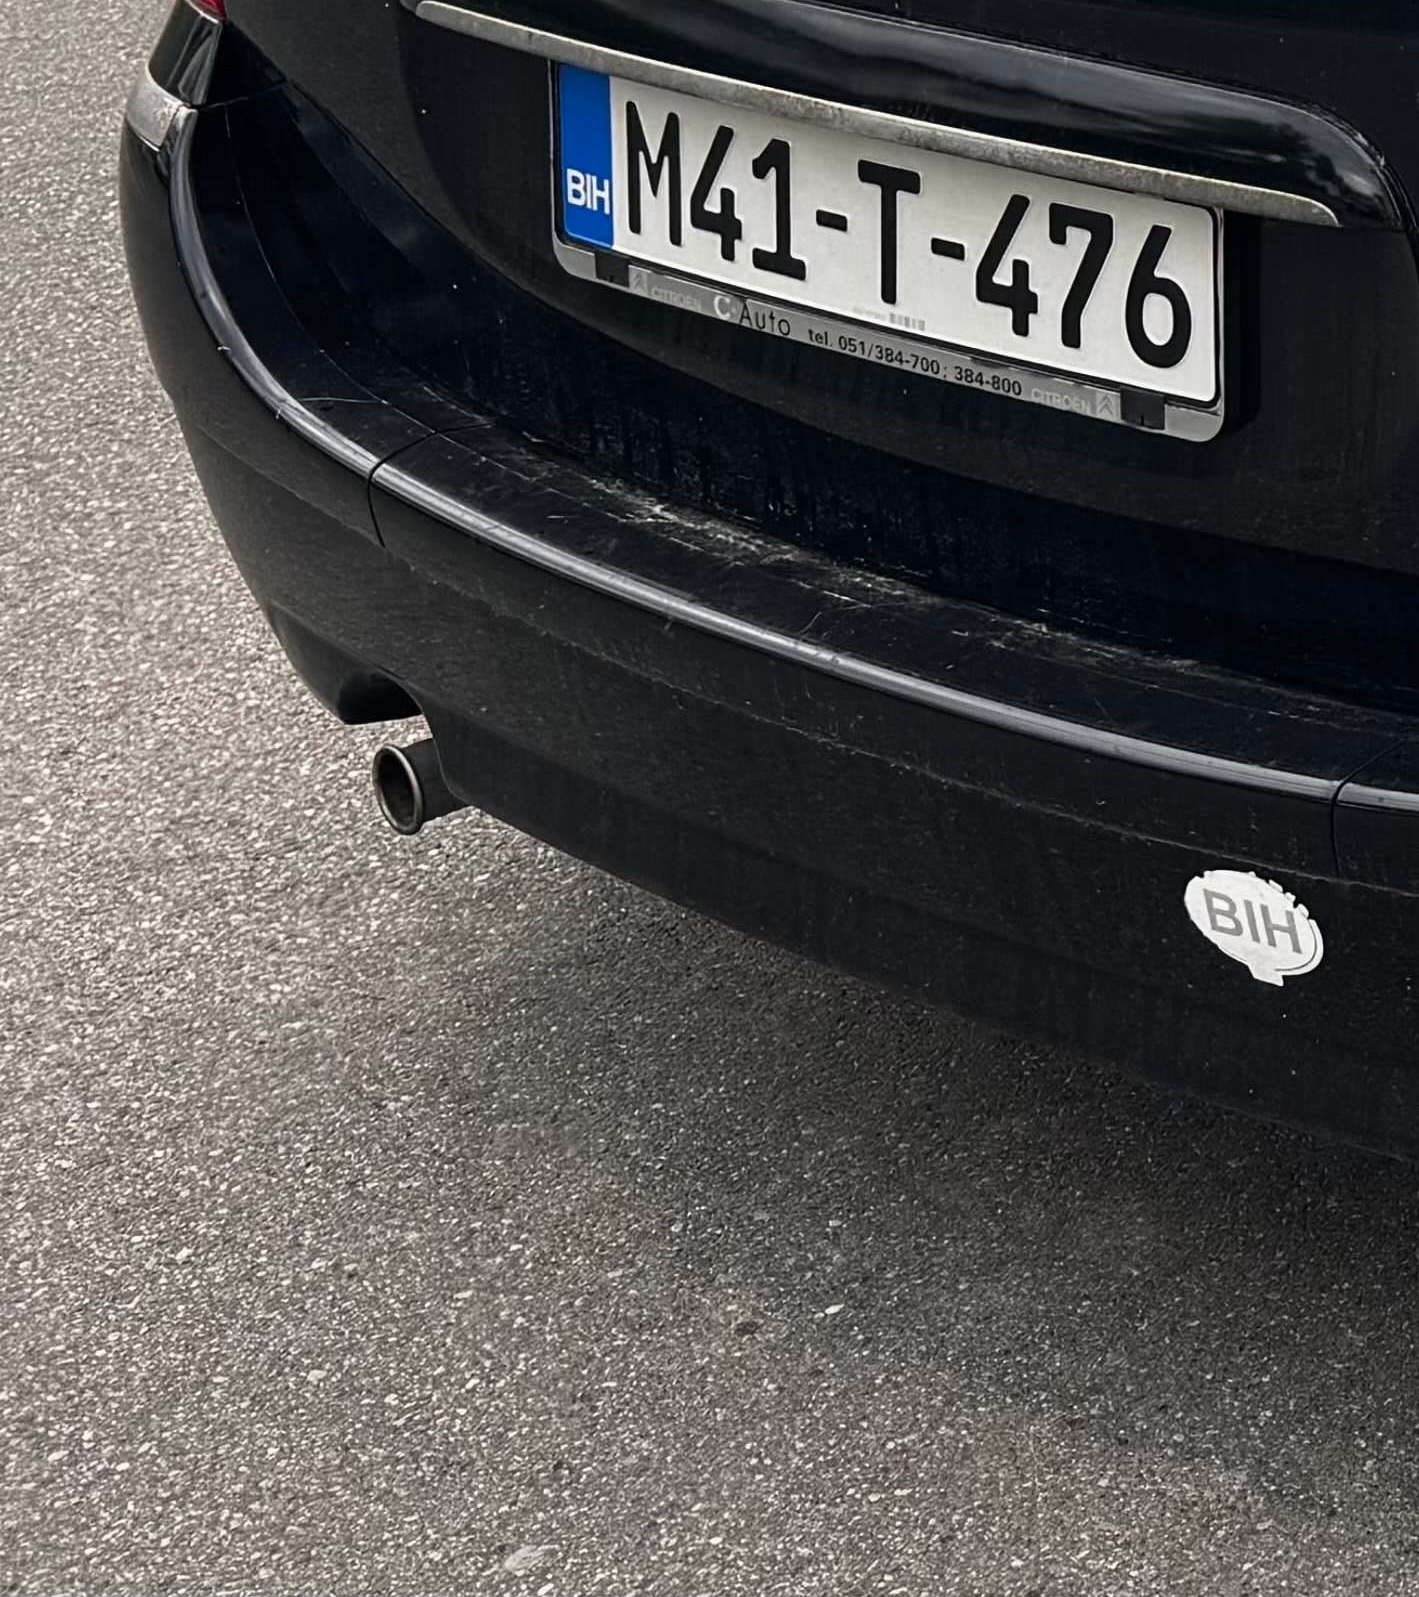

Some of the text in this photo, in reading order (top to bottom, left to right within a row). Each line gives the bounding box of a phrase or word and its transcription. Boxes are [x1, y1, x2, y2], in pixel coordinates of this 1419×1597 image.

[566, 168, 611, 215] BIH
[625, 100, 1193, 369] M41-T-476
[807, 328, 834, 349] tel.
[953, 365, 1023, 397] 384-800
[1203, 888, 1303, 955] BIH
